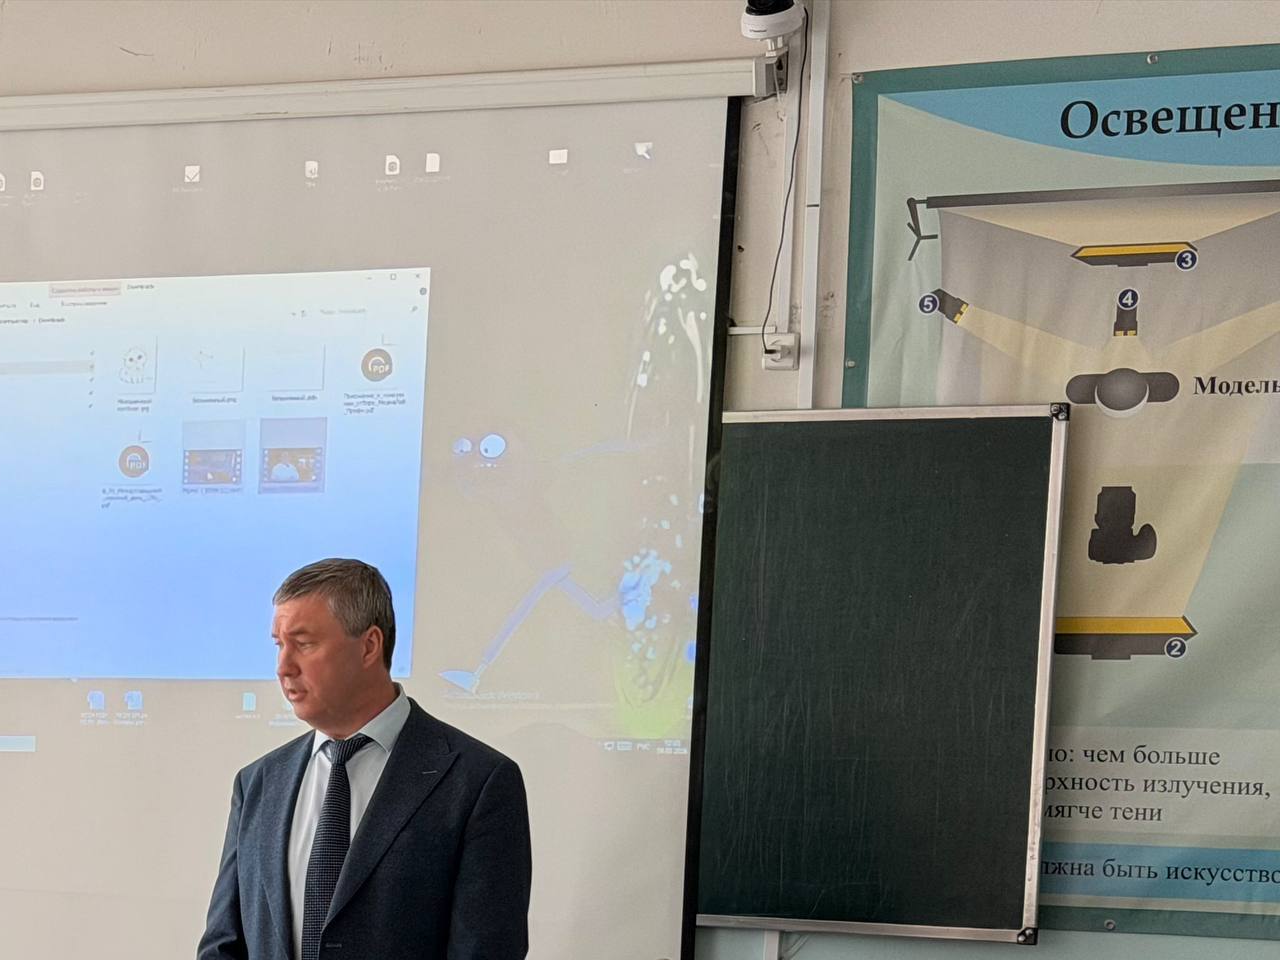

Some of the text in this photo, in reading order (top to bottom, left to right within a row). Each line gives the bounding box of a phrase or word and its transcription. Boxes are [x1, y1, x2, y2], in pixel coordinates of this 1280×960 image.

[1060, 100, 1280, 139] Освещен
[1182, 253, 1193, 267] 3
[923, 298, 934, 311] 5
[1122, 292, 1134, 305] 4
[1171, 641, 1182, 655] 2
[1083, 748, 1125, 763] чем
[1133, 745, 1220, 766] больше
[1143, 778, 1271, 799] излучения,
[1110, 805, 1163, 821] тени
[1102, 858, 1158, 879] быть
